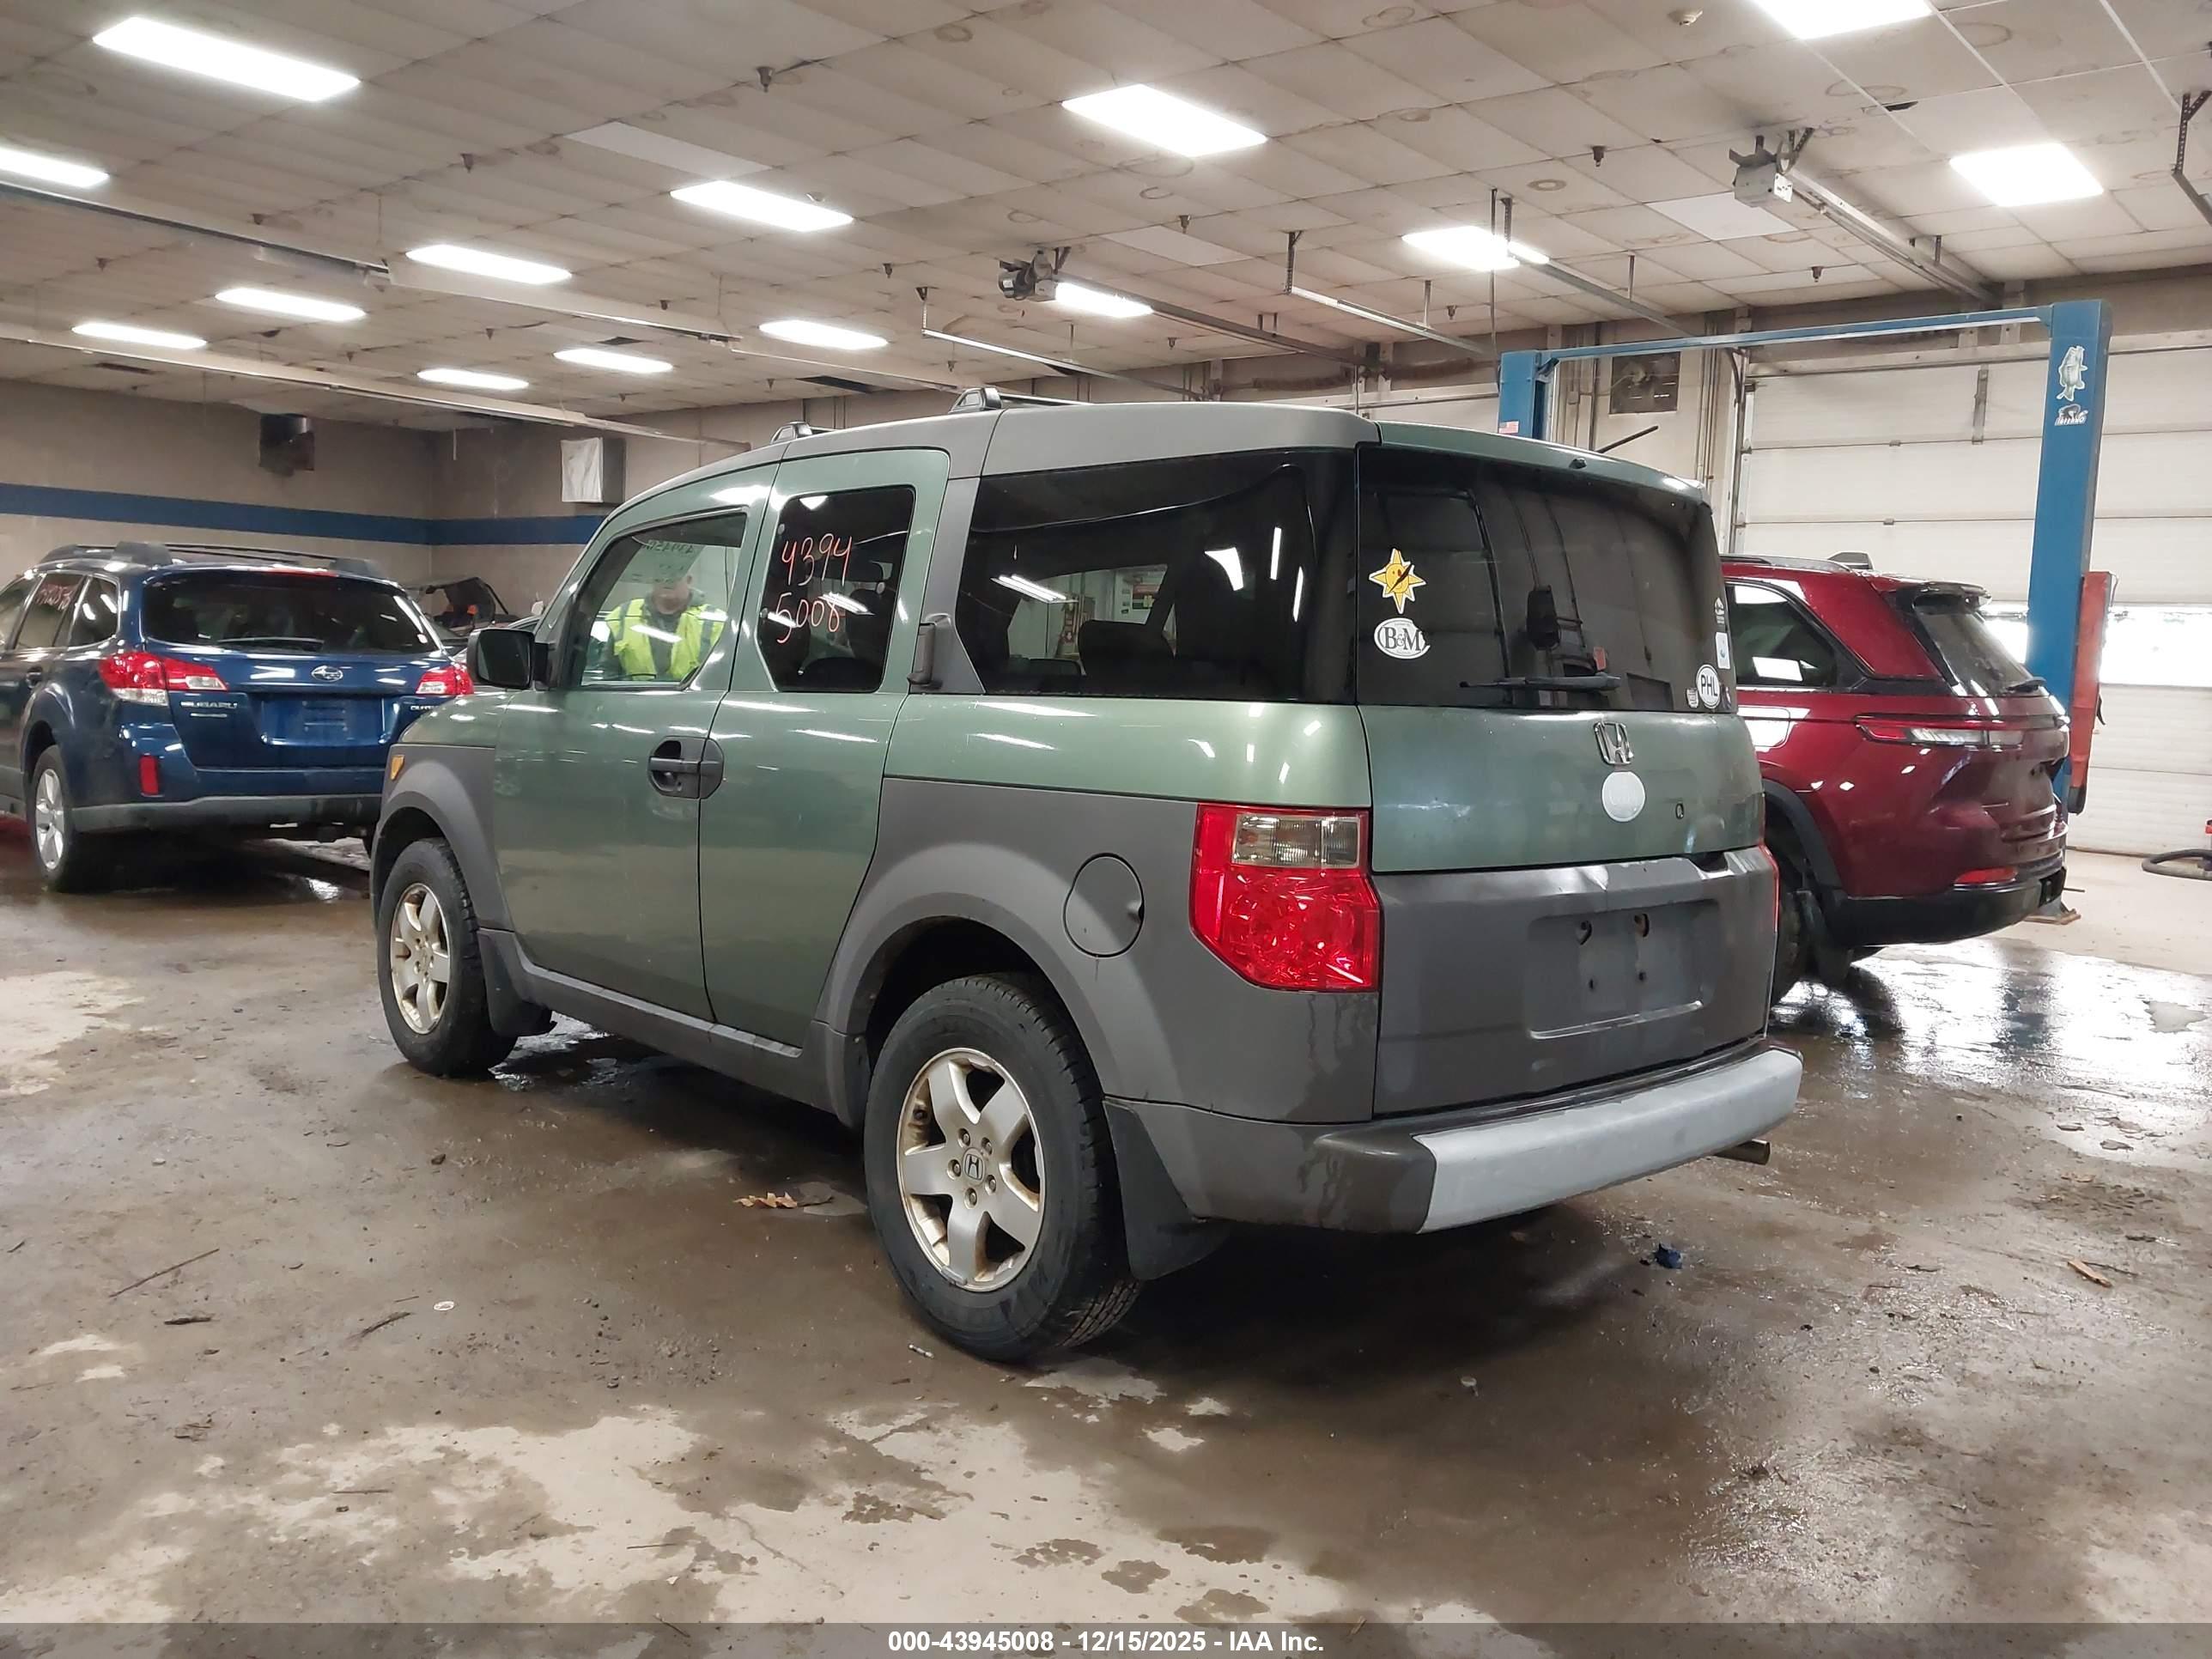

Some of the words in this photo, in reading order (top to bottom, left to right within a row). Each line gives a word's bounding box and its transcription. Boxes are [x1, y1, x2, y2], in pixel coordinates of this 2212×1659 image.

[781, 532, 852, 586] 4394
[776, 592, 840, 643] 5008
[1383, 626, 1421, 652] B&M
[1701, 675, 1718, 696] PHL
